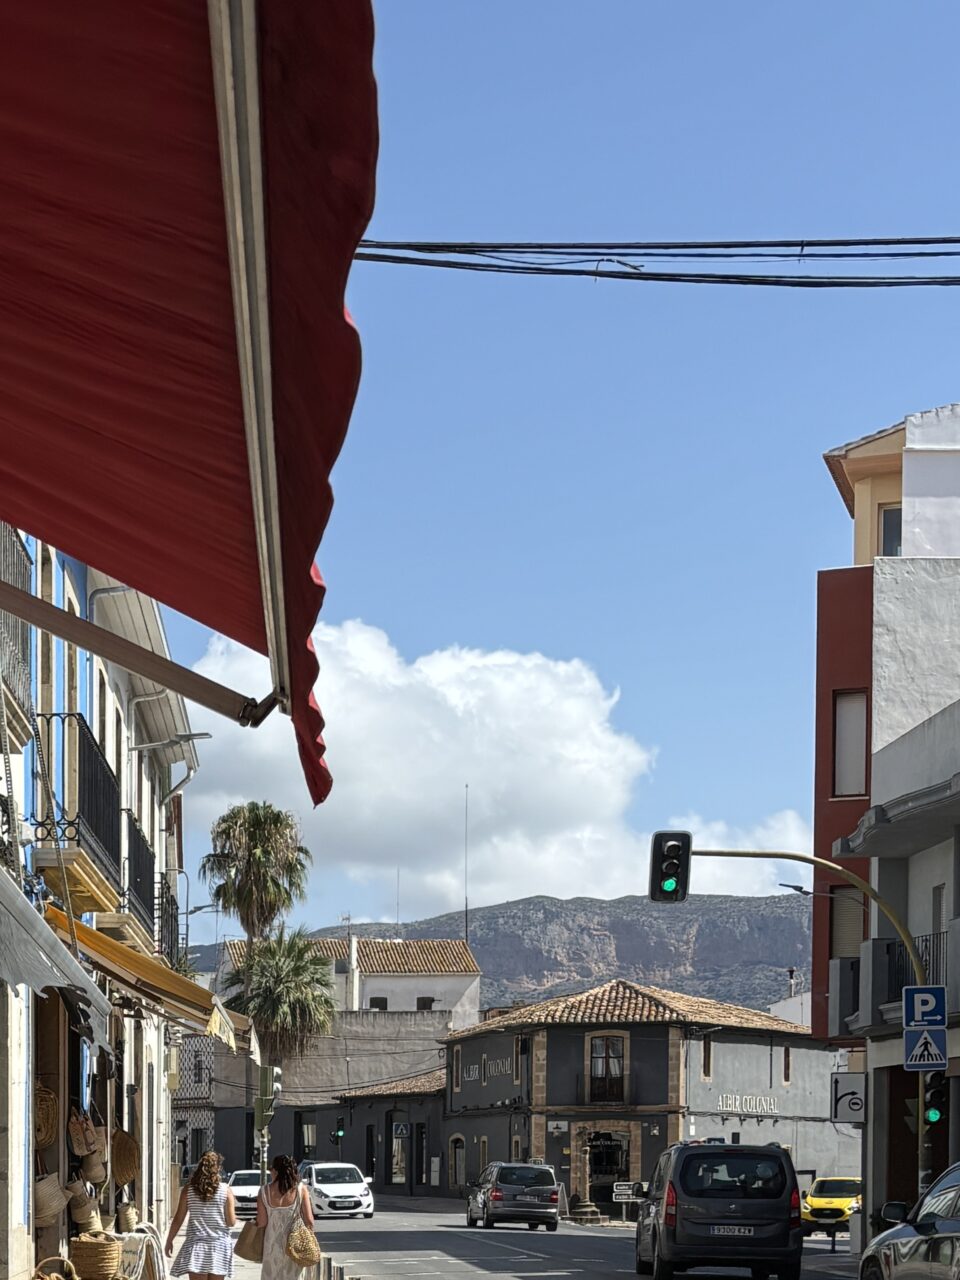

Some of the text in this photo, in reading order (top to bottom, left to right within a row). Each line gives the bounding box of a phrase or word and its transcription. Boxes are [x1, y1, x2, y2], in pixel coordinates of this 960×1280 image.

[914, 993, 936, 1021] P
[717, 1094, 779, 1113] ALBIR COLONIAL
